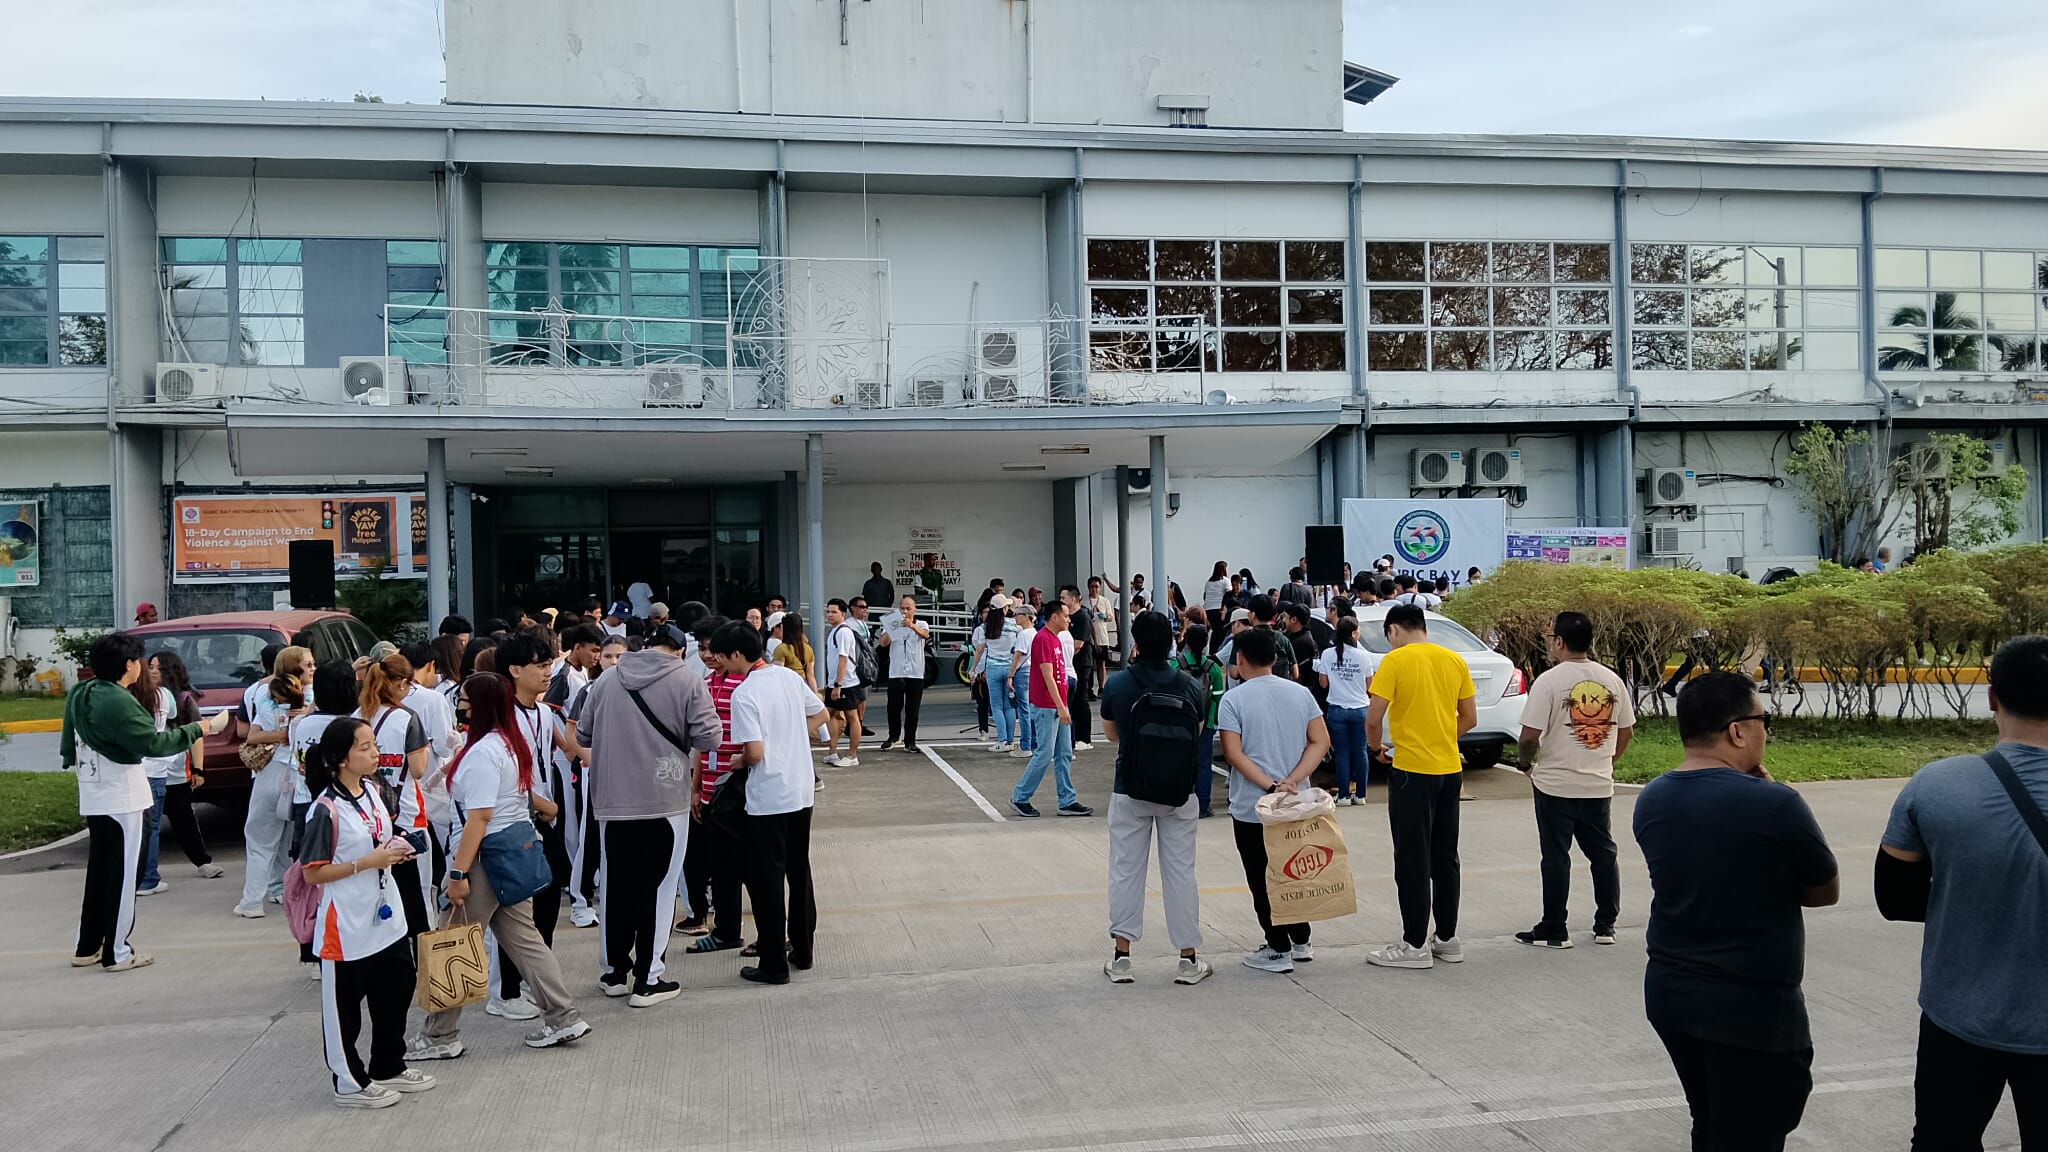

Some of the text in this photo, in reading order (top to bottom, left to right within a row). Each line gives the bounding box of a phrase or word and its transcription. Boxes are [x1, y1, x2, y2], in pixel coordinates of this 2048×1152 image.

[355, 521, 377, 530] VAW
[411, 520, 426, 529] AW
[185, 526, 314, 538] 18-Day Campaign to End
[356, 530, 376, 538] free
[185, 539, 231, 548] Violence
[233, 538, 273, 548] Against
[941, 552, 946, 560] A
[909, 561, 925, 569] DRU
[1429, 569, 1460, 582] BAY
[1280, 882, 1345, 902] PHENOLIC RESIN
